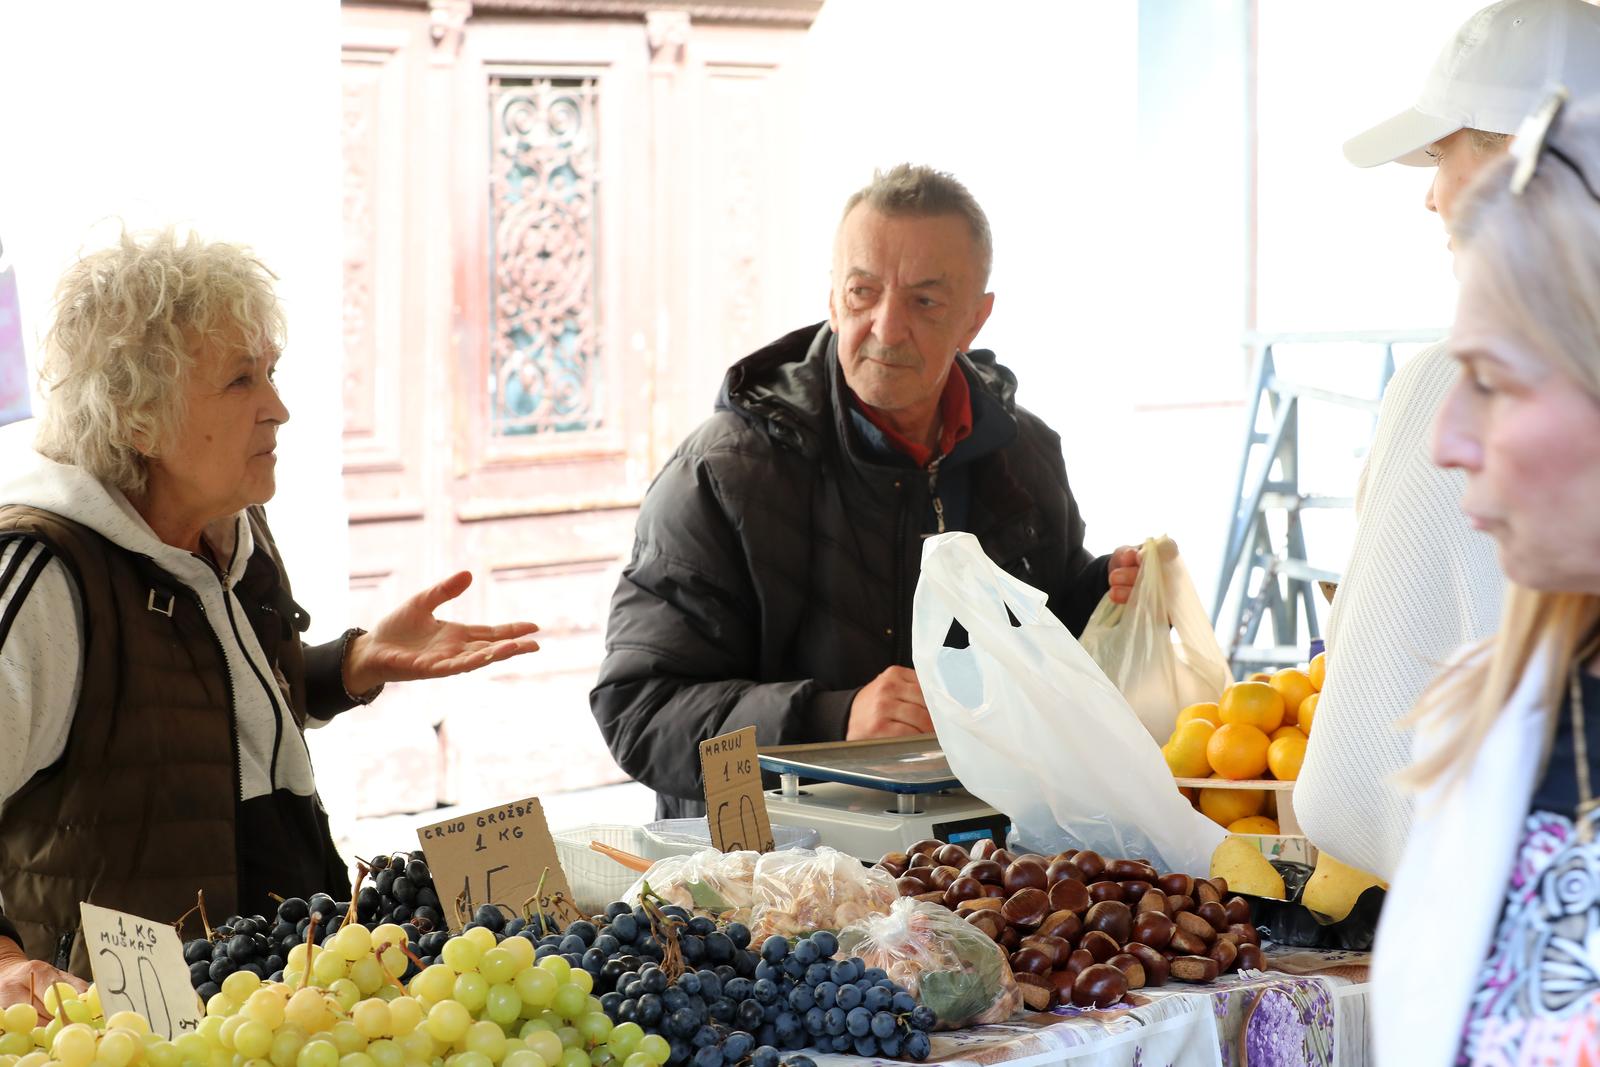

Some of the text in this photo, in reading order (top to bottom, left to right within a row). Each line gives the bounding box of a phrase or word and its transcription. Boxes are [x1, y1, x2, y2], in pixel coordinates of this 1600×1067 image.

[723, 759, 752, 782] 1 KG
[425, 822, 465, 840] CRNO
[475, 826, 524, 852] 1 KG
[118, 915, 157, 945] 1 KG
